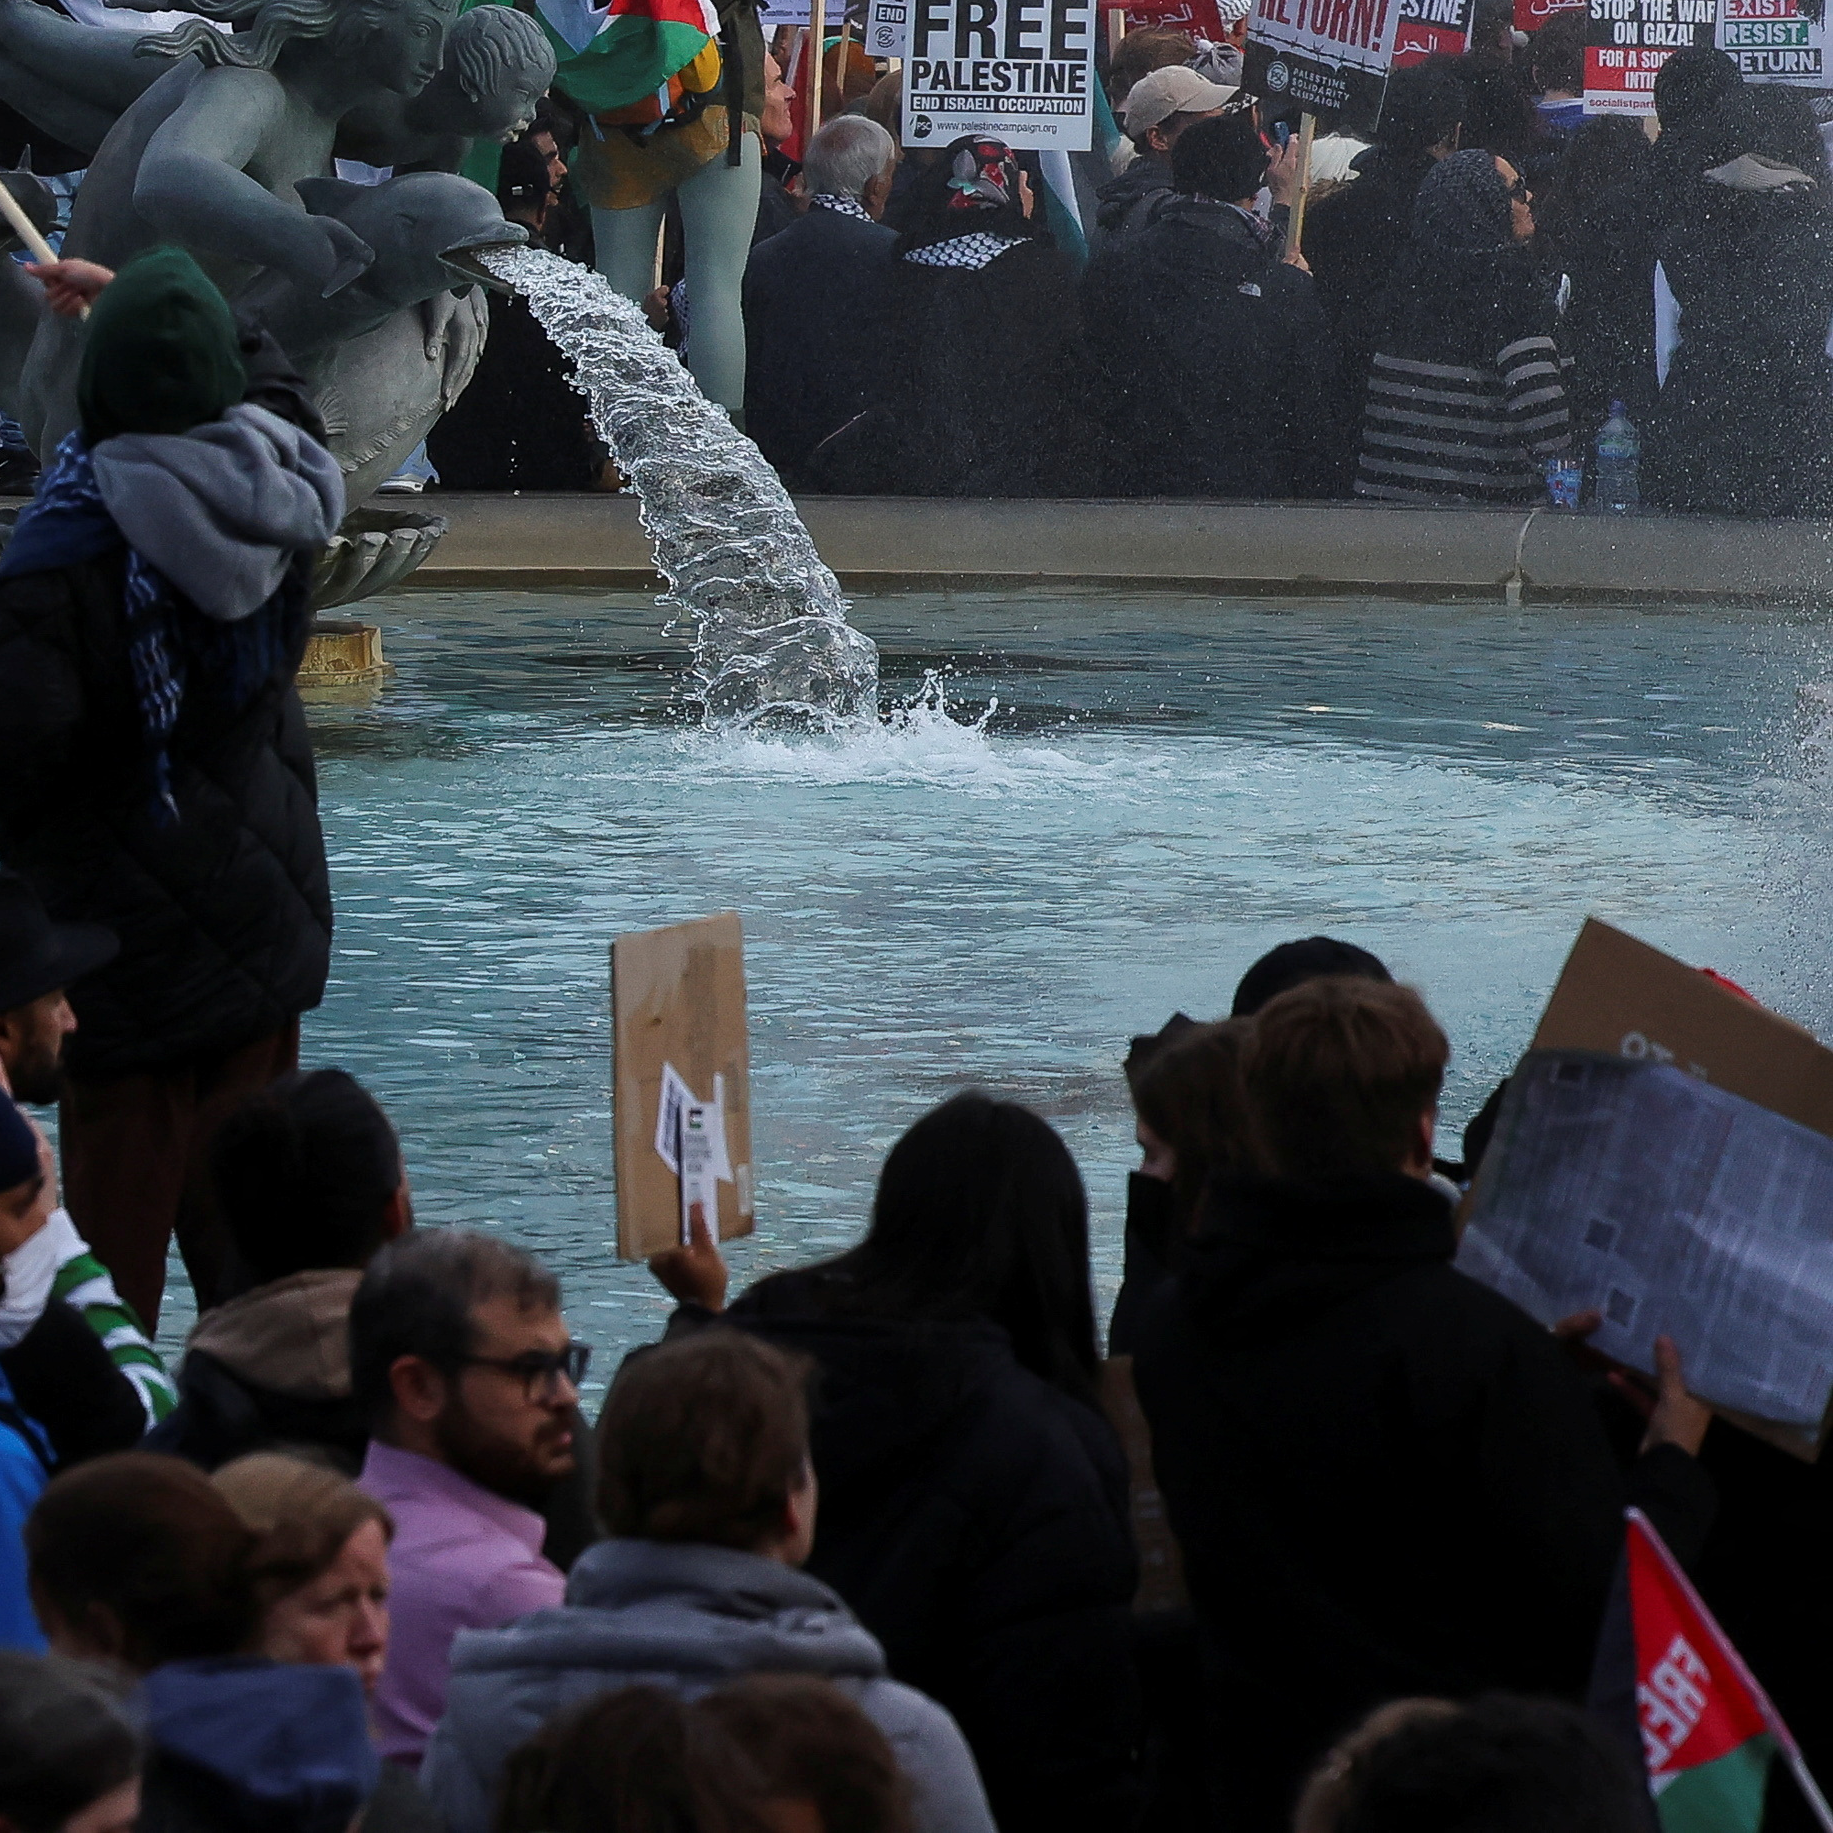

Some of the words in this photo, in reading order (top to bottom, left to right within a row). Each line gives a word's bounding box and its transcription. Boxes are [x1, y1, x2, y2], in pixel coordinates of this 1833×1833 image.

[1639, 0, 1673, 22] THE
[1613, 22, 1638, 45] ON
[1643, 23, 1694, 46] GAZA!
[1724, 21, 1808, 45] RESIST.
[1599, 50, 1623, 67] FOR
[1626, 51, 1638, 67] A
[911, 59, 1087, 95] PALESTINE
[1293, 66, 1346, 91] PALESTINE
[1289, 88, 1342, 109] CAMPAIGN
[1291, 77, 1350, 100] SOLIDARITY
[912, 96, 939, 111] END
[943, 97, 994, 112] ISRAELI
[998, 97, 1083, 113] OCCUPATION
[937, 120, 1058, 135] www.palestinecampaign.org
